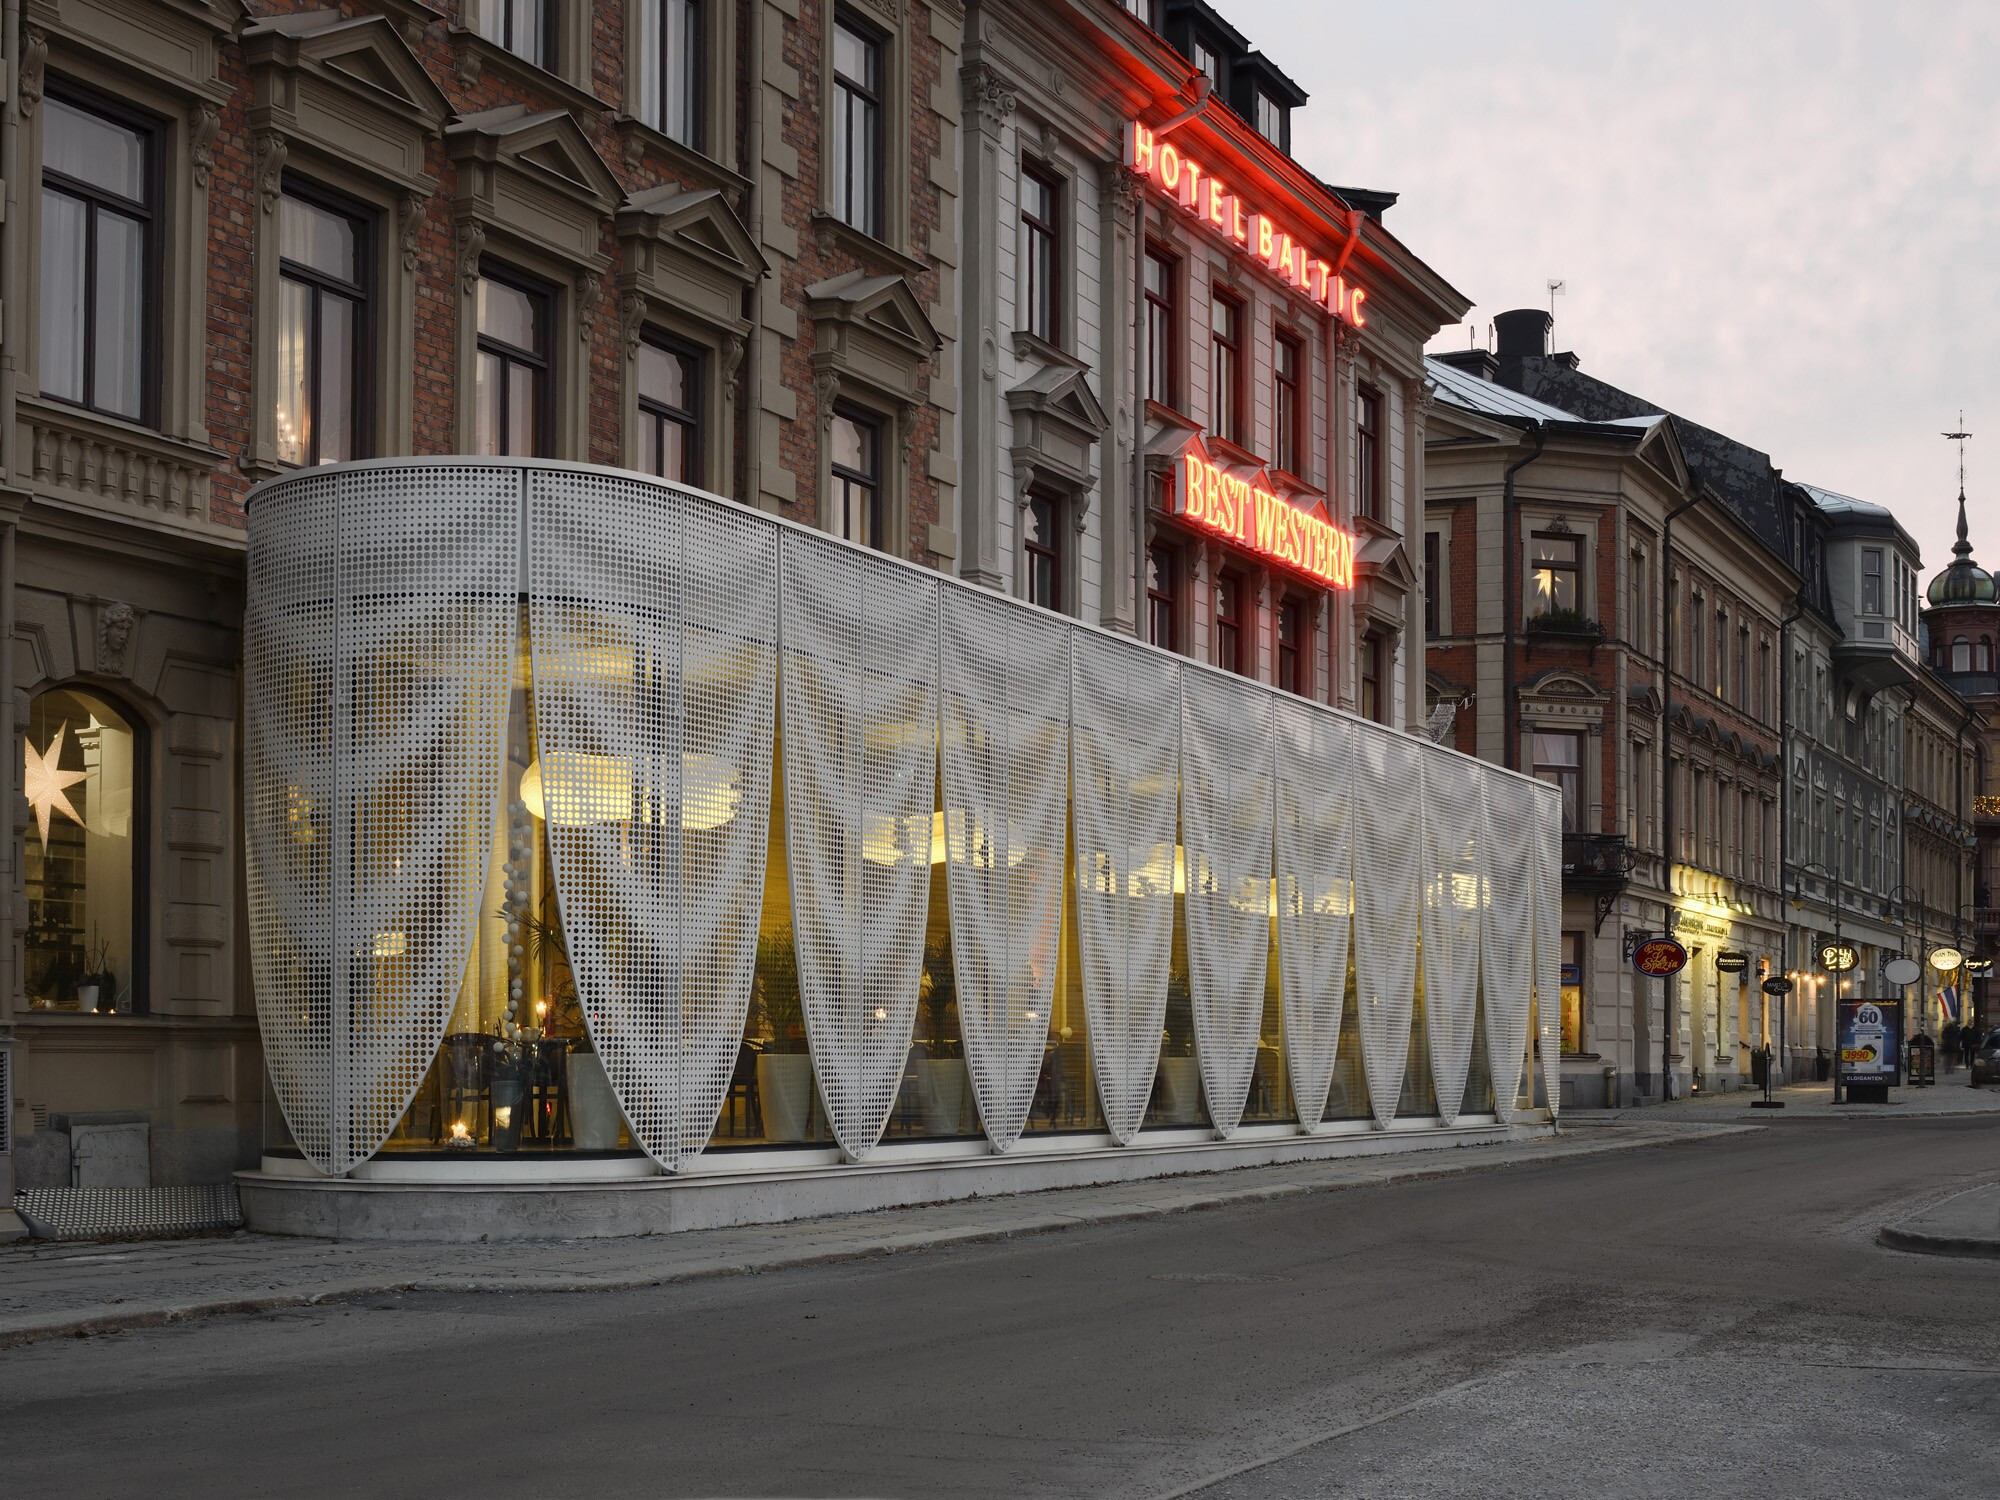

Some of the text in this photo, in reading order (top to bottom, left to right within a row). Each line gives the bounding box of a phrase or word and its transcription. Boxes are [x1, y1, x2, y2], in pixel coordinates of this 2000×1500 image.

[1135, 121, 1365, 329] HOTEL BALTIC
[1185, 455, 1355, 590] BEST WESTERN
[1644, 943, 1677, 954] Pizzeria
[1642, 958, 1679, 973] Spezia
[1859, 1011, 1879, 1024] 60
[1844, 1050, 1870, 1060] 3990
